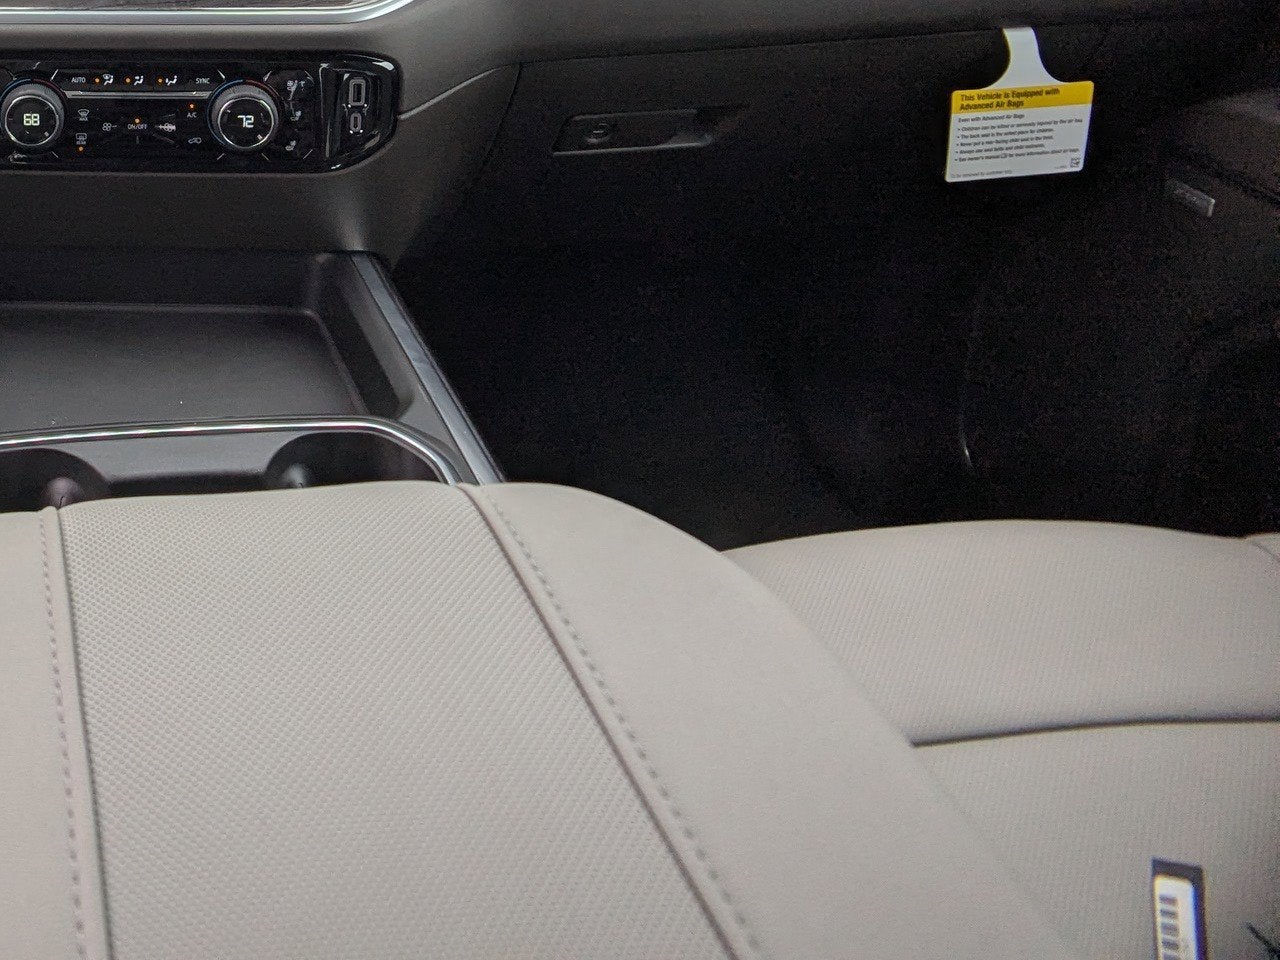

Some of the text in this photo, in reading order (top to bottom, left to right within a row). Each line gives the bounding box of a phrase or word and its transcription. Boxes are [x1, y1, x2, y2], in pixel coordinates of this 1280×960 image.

[71, 76, 86, 84] AUTO
[195, 77, 210, 85] SYNC
[960, 88, 1060, 101] This Vehicle is Equipped with
[960, 99, 1024, 110] Advanced Air Bags
[23, 113, 40, 126] 68
[237, 115, 254, 128] 72
[127, 122, 147, 131] ON/OFF
